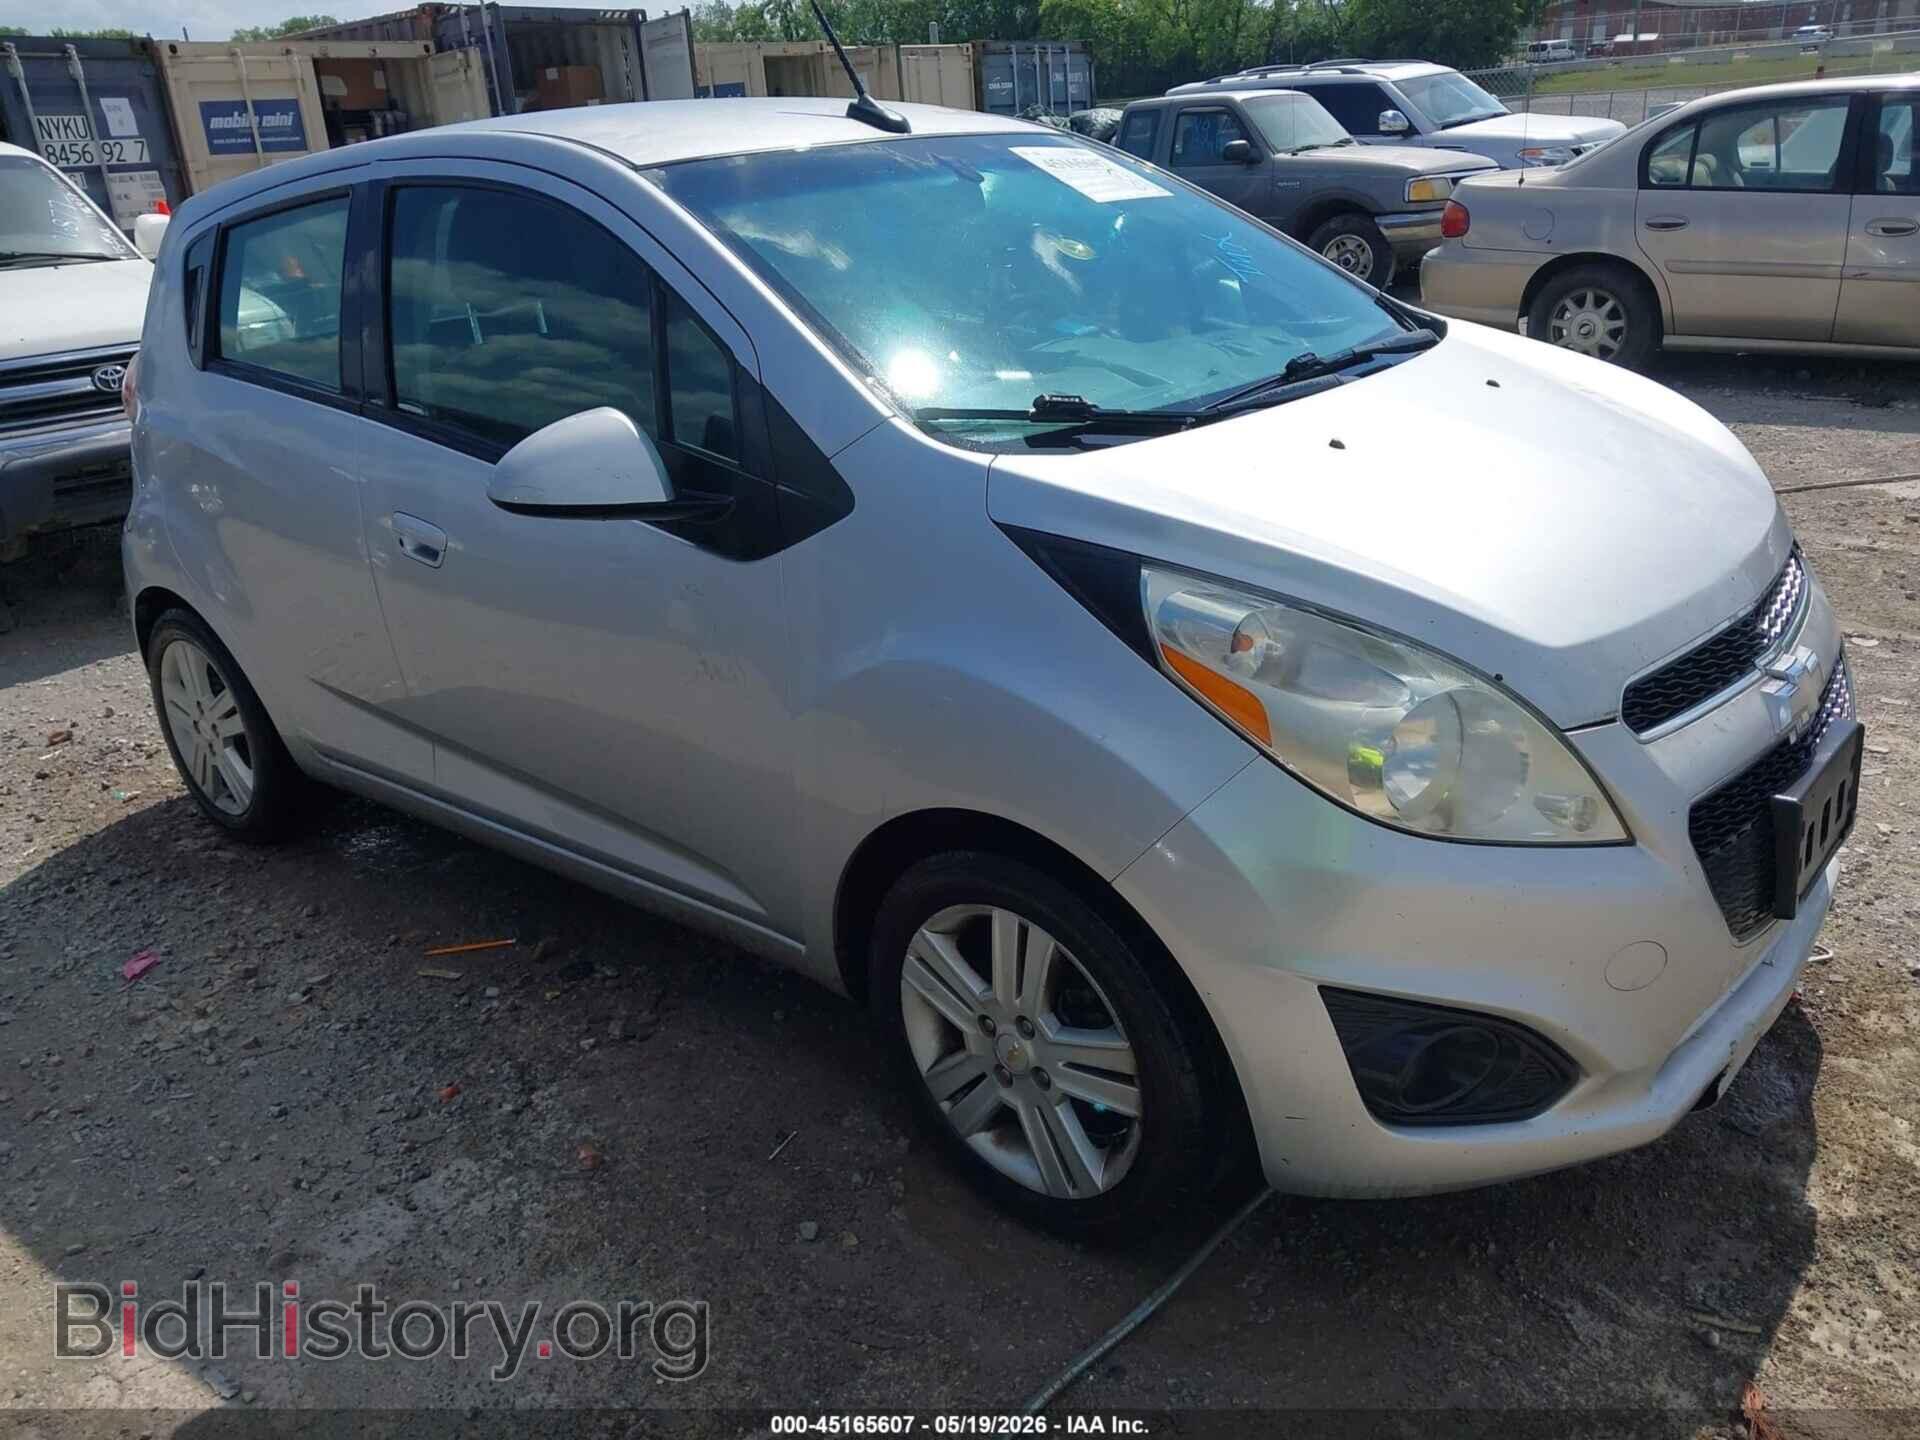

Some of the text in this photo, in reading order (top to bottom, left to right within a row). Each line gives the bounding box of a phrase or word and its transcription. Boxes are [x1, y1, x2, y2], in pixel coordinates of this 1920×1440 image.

[36, 116, 89, 140] NYKU
[261, 111, 294, 127] mini
[44, 140, 146, 166] 8456 92 7
